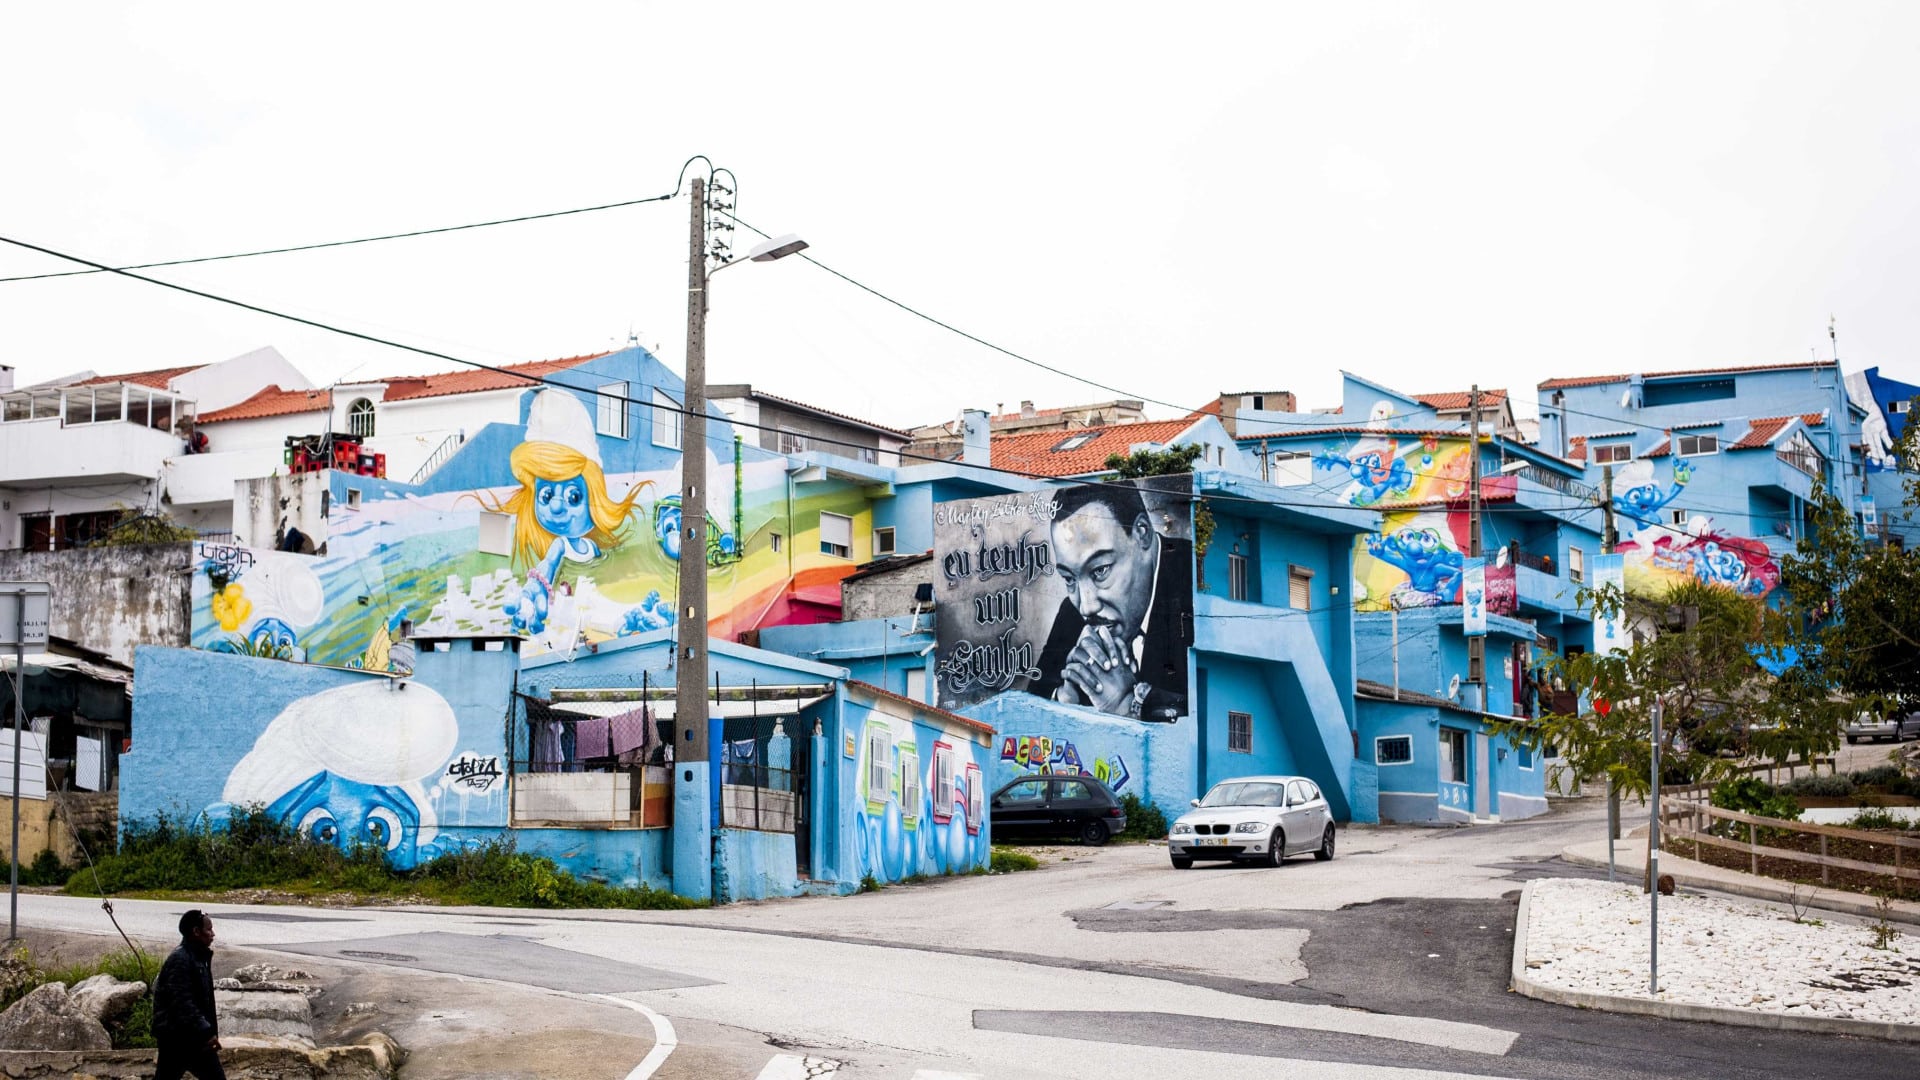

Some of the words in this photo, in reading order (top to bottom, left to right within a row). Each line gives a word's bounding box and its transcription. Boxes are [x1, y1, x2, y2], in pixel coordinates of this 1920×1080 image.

[1028, 491, 1062, 521] King
[976, 529, 1054, 585] tenho
[975, 587, 1020, 626] um
[1605, 623, 1615, 639] 2
[1002, 737, 1081, 764] ACORDA
